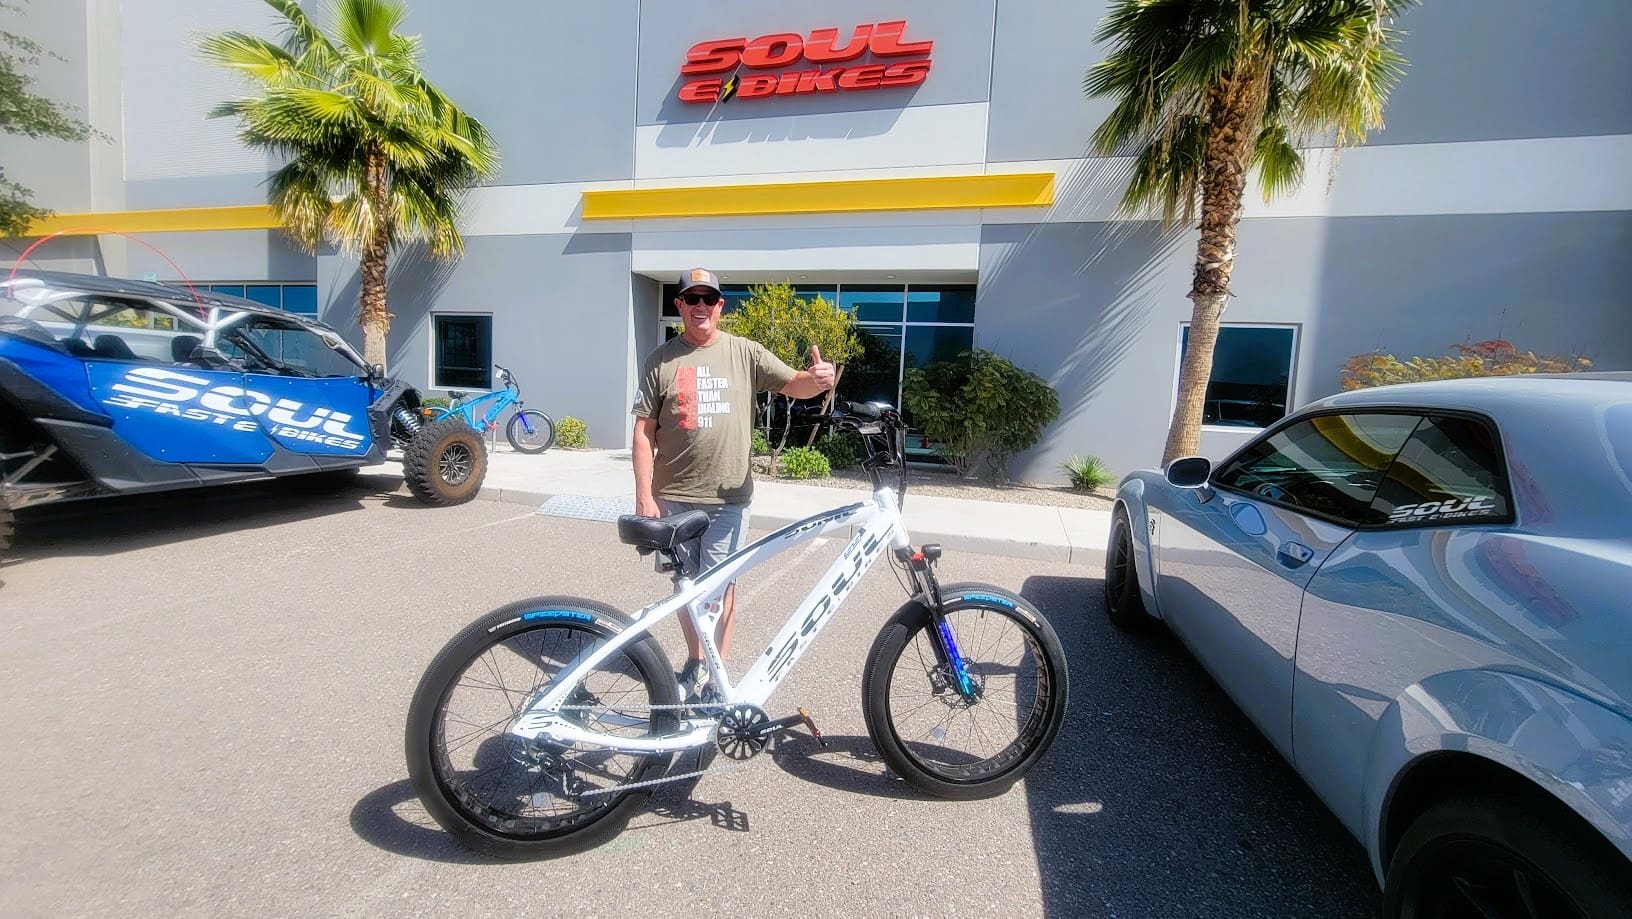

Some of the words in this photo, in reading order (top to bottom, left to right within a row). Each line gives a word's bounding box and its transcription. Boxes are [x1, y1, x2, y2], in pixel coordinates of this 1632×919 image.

[682, 20, 934, 75] SOUL
[678, 77, 720, 102] E
[736, 58, 932, 98] BIKES
[696, 366, 711, 377] ALL
[697, 378, 728, 389] FASTER
[697, 391, 721, 402] THAN
[112, 368, 364, 440] SOUL
[697, 402, 731, 414] DIALING
[103, 395, 236, 425] FAST
[278, 426, 361, 450] BIKES
[697, 416, 713, 428] 911
[1389, 496, 1495, 519] SOUL
[767, 523, 893, 682] SOUL
[963, 594, 1014, 607] SPEEDSTER
[523, 610, 593, 622] SPEEDSTER
[760, 724, 784, 735] SOUL
